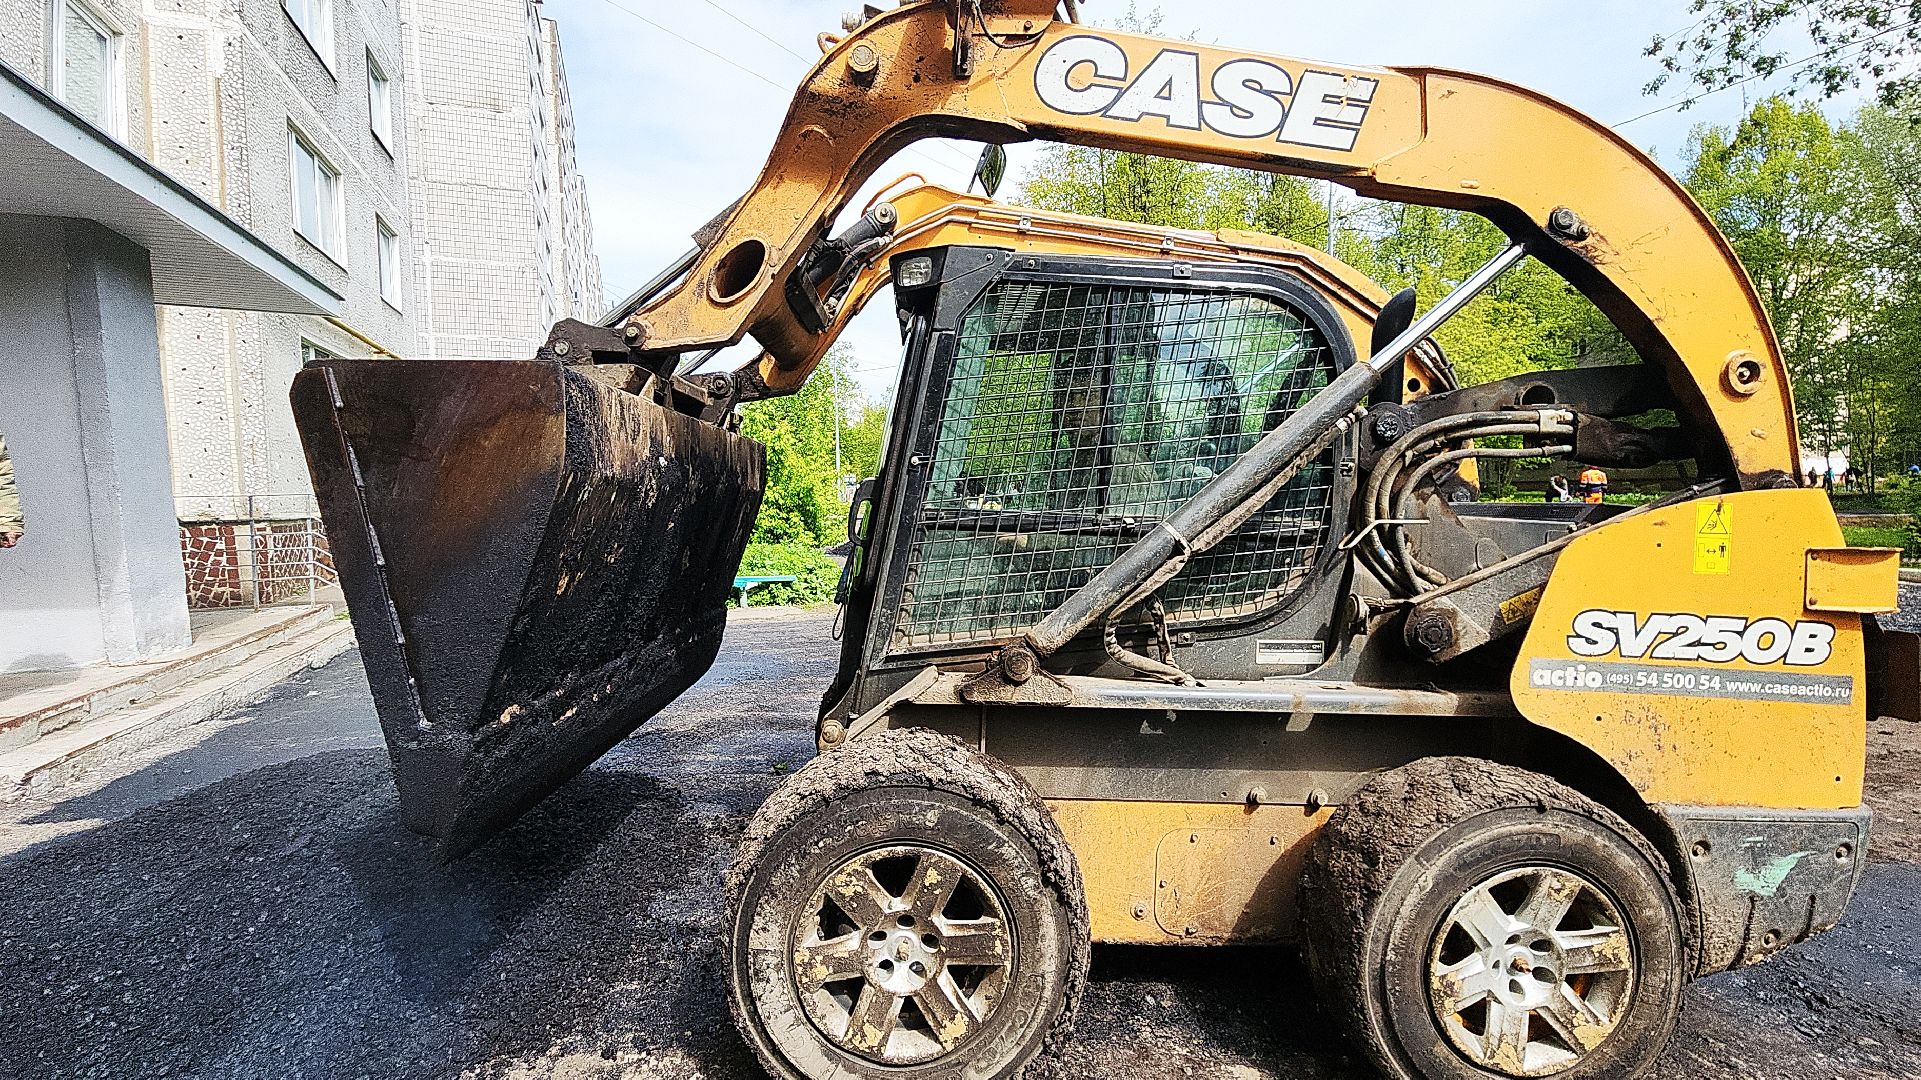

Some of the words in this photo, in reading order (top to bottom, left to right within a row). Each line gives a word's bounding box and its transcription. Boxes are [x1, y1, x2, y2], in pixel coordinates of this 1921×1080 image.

[1034, 35, 1380, 152] CASE
[1567, 609, 1836, 666] SV250B
[1533, 664, 1602, 688] actio
[1606, 673, 1633, 685] (495)
[1636, 670, 1658, 687] 54
[1661, 674, 1696, 688] 500
[1699, 675, 1721, 691] 54
[1726, 681, 1850, 697] www.caseactio.ru
